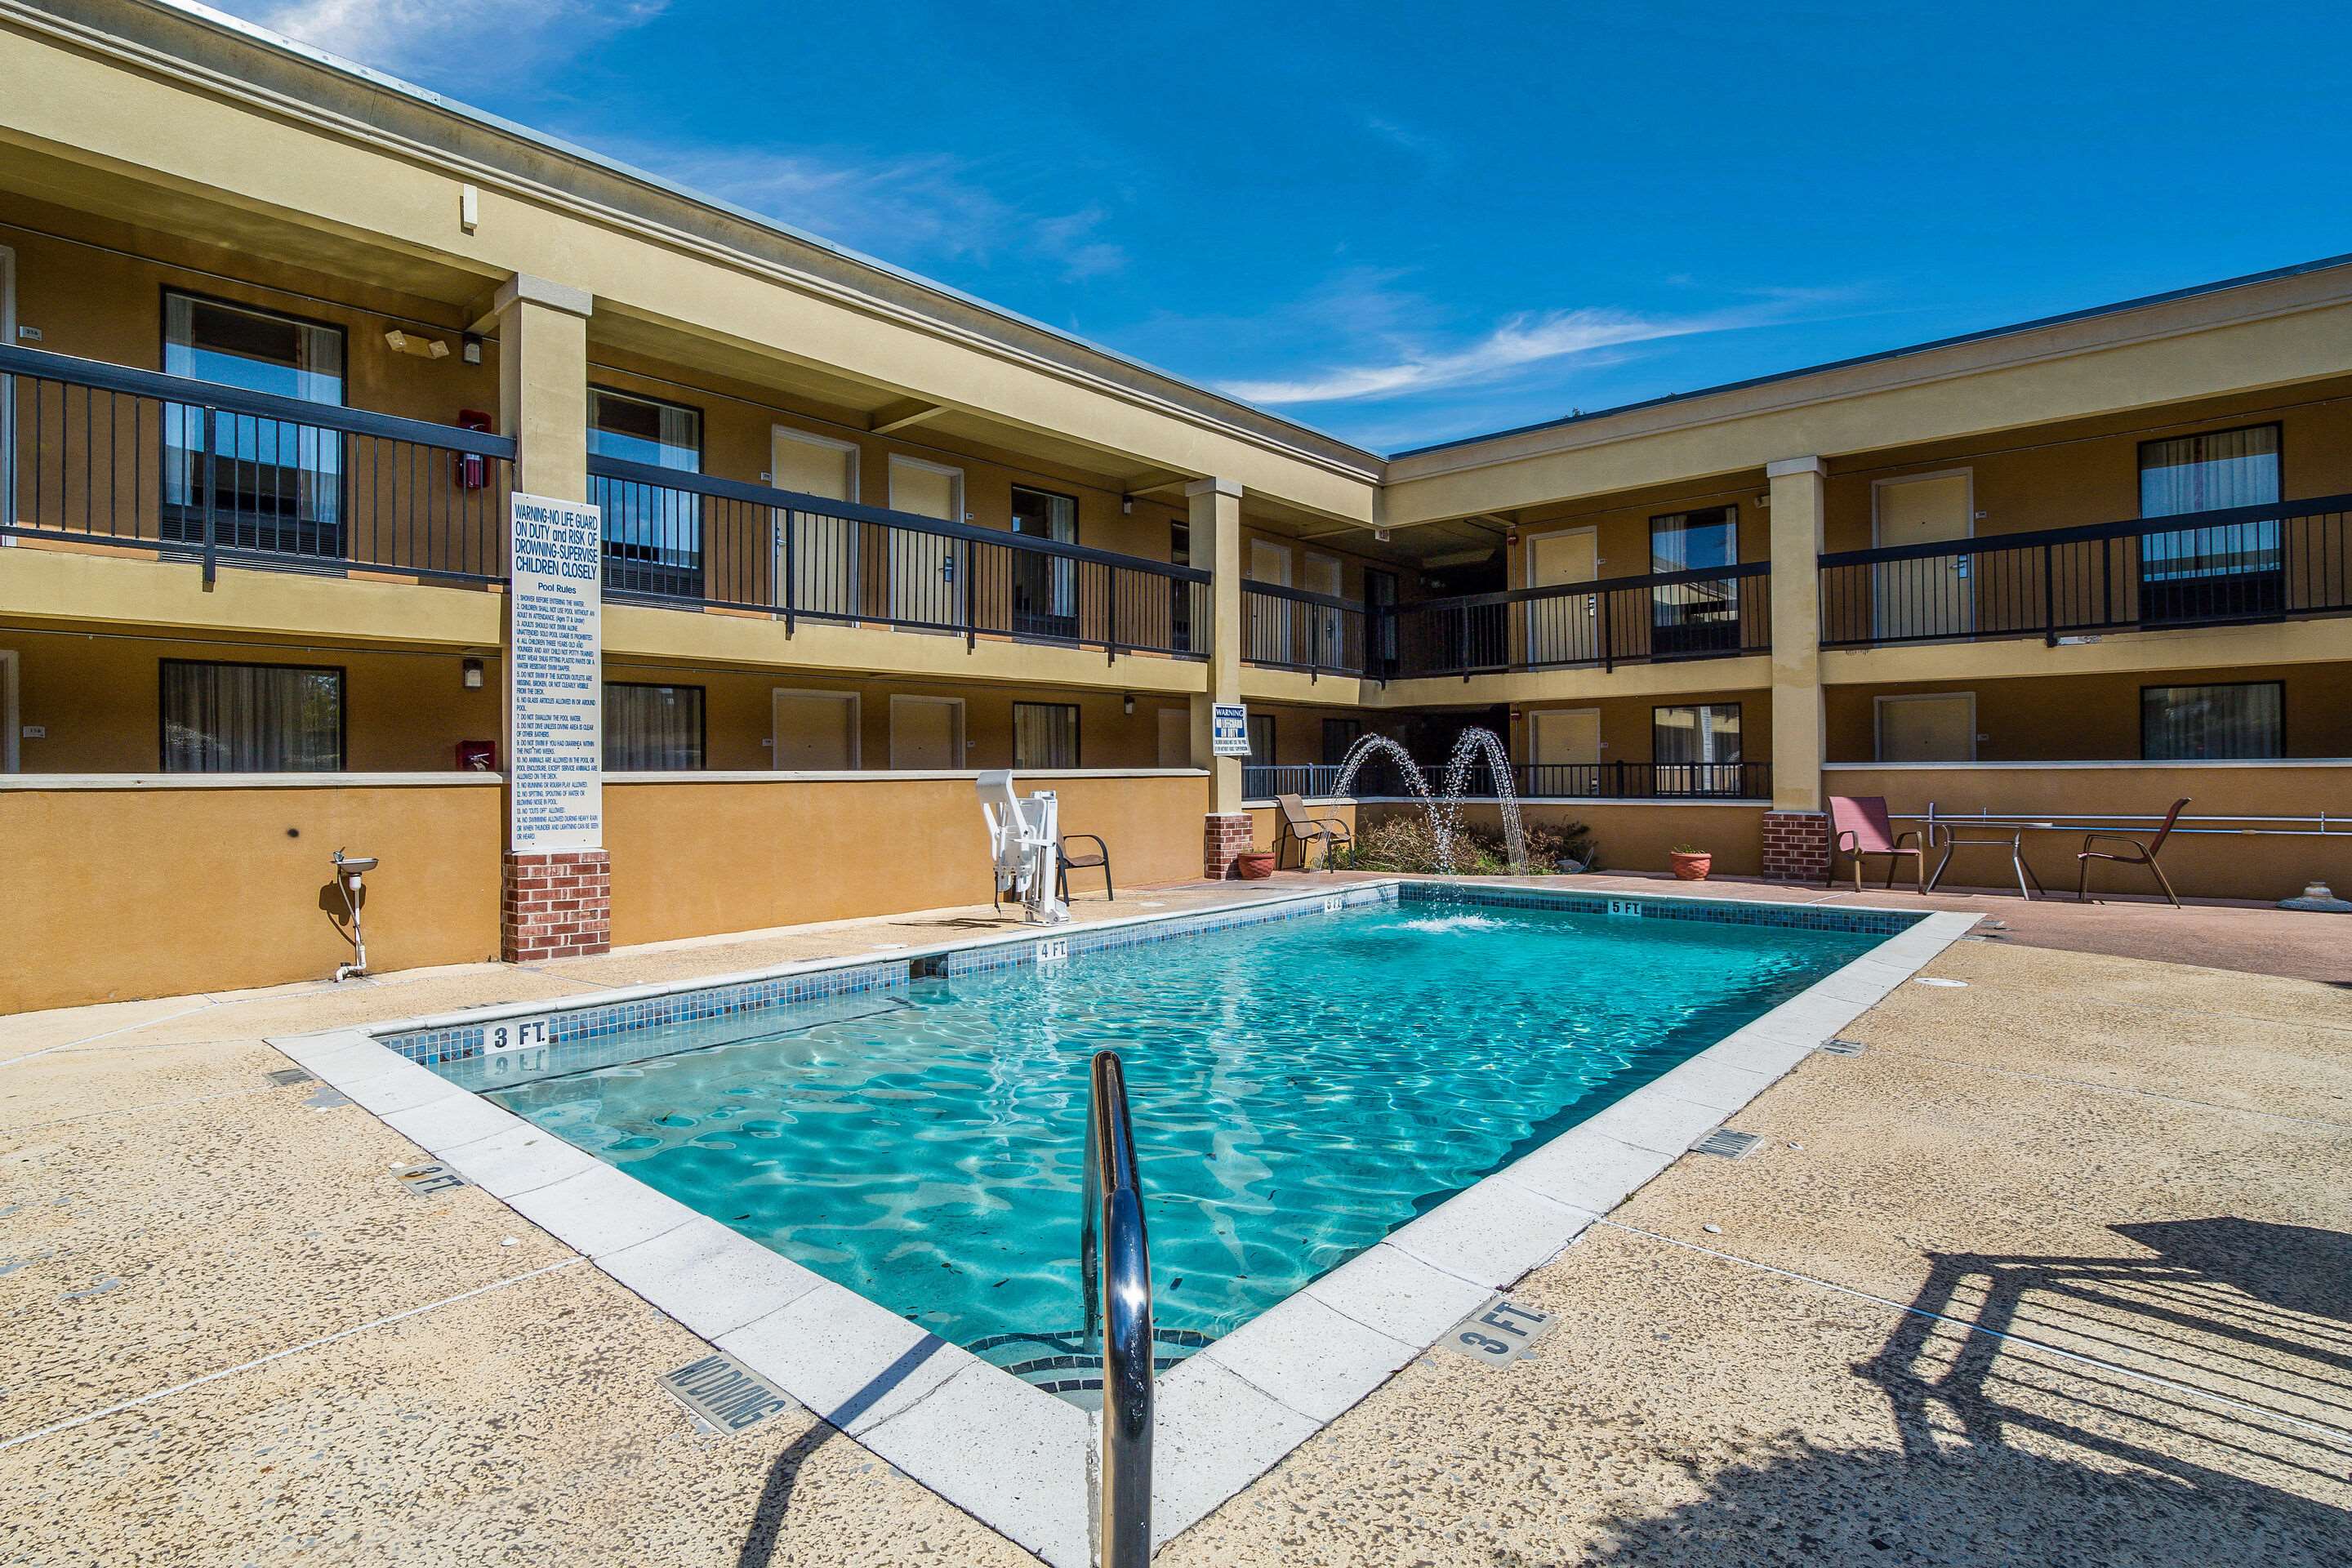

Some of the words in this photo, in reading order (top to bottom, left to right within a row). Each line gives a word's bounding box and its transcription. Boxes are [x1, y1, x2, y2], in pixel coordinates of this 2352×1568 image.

[515, 504, 559, 525] WARNING-NO
[562, 511, 573, 527] LIFE
[576, 513, 597, 531] GUARD
[516, 521, 527, 538] ON
[530, 523, 550, 541] DUTY
[553, 527, 566, 543] and
[569, 529, 585, 545] RISK
[588, 532, 597, 547] OF
[515, 539, 598, 564] DROWNING-SUPERVISE
[516, 556, 559, 576] CHILDREN
[562, 562, 597, 580] CLOSELY
[538, 583, 554, 592] Pool
[557, 585, 576, 594] Rules
[1216, 708, 1244, 717] WARNING
[1613, 902, 1619, 912] 5
[1625, 902, 1640, 915] FT.
[1042, 943, 1048, 958] 4
[1053, 941, 1066, 956] FT.
[494, 1027, 507, 1048] 3
[519, 1021, 546, 1045] FT.
[405, 1166, 443, 1178] 3
[1479, 1301, 1548, 1337] FT.
[1459, 1331, 1509, 1355] 3
[665, 1355, 731, 1387] NO
[685, 1370, 786, 1430] DIVING
